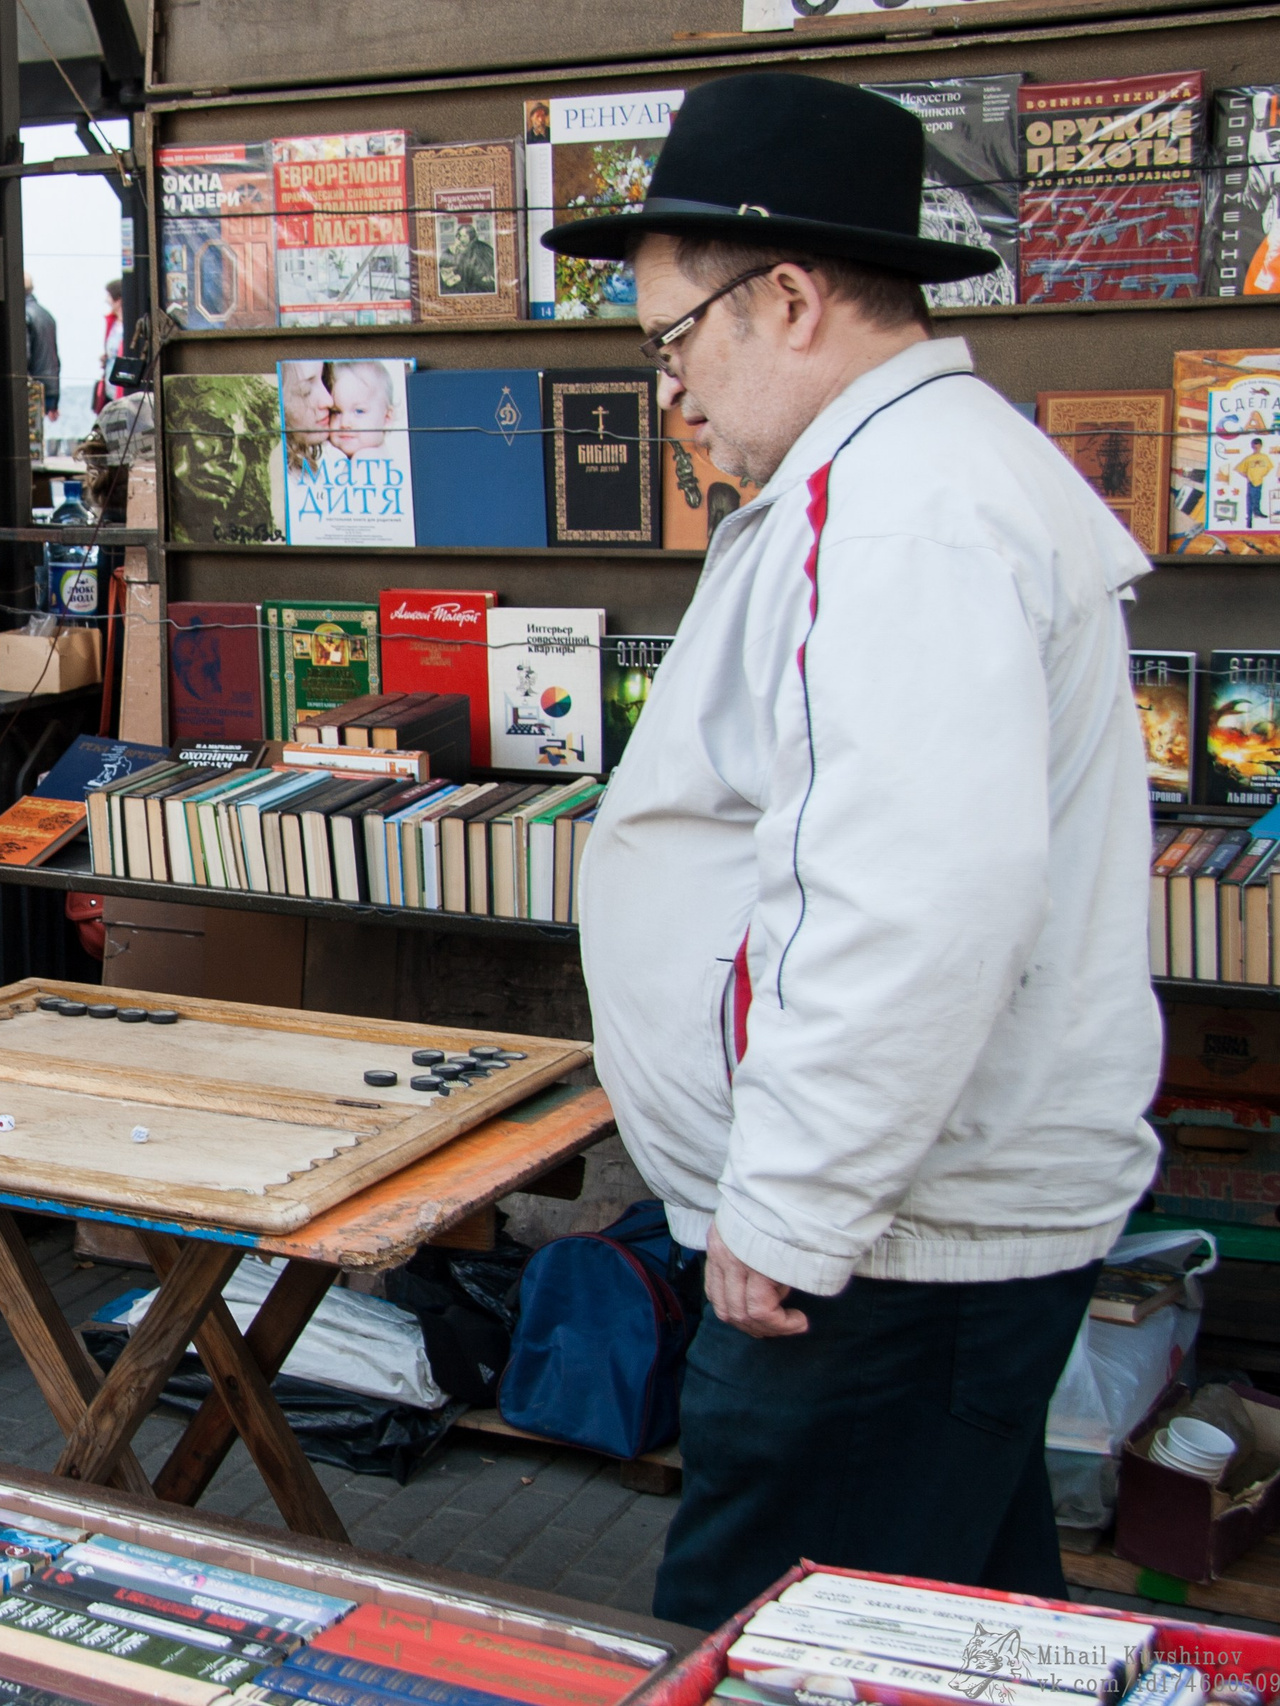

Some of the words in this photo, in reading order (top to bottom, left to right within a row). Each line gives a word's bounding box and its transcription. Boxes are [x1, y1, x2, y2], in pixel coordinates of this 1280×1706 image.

[900, 91, 962, 106] Искусство
[1026, 95, 1103, 109] ВОЕННАЯ
[1113, 88, 1192, 103] ТЕХНИКА
[563, 102, 671, 130] РЕНУАР
[1025, 109, 1192, 146] ОРУЖИЕ
[1026, 137, 1192, 174] ПЕХОТЫ
[162, 173, 223, 194] ОКНА
[279, 159, 402, 188] ЕВРОРЕМОНТ
[1056, 174, 1113, 186] ЛУЧШИХ
[1118, 169, 1191, 182] ОБРАЗЦОВ
[163, 195, 176, 210] И
[180, 189, 240, 213] ДВЕРИ
[1219, 97, 1247, 297] СОВРЕМЕННОЕ
[313, 217, 406, 245] МАСТЕРА
[540, 306, 552, 317] 14
[578, 444, 628, 464] БИБЛИЯ
[527, 624, 572, 635] Интерьер
[527, 635, 590, 646] современной
[528, 645, 576, 656] квартиры
[179, 752, 249, 763] ОХОТНИЧЬИ
[1227, 792, 1273, 805] ЛЬВИНОЕ
[829, 1655, 879, 1674] СЛЕД
[888, 1665, 944, 1685] ТИГРА
